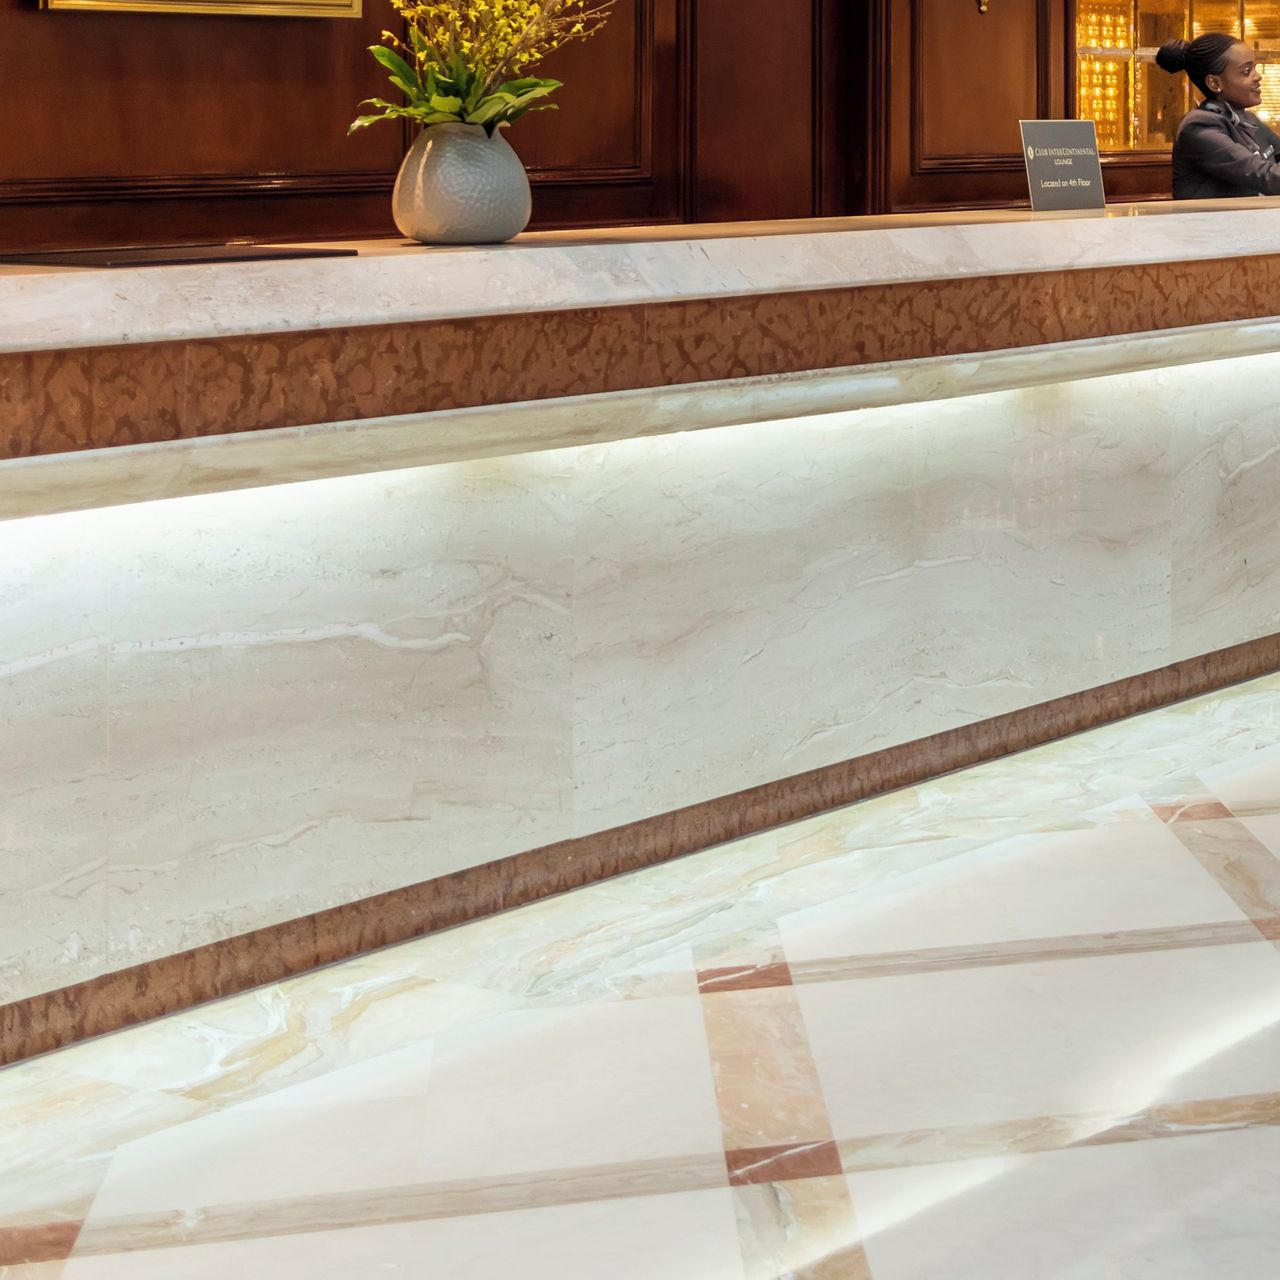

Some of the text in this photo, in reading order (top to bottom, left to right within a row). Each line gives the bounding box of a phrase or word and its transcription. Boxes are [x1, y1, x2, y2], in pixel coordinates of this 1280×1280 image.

[1040, 179, 1061, 188] Located
[1069, 179, 1077, 187] 4th
[1078, 178, 1091, 187] Floor
